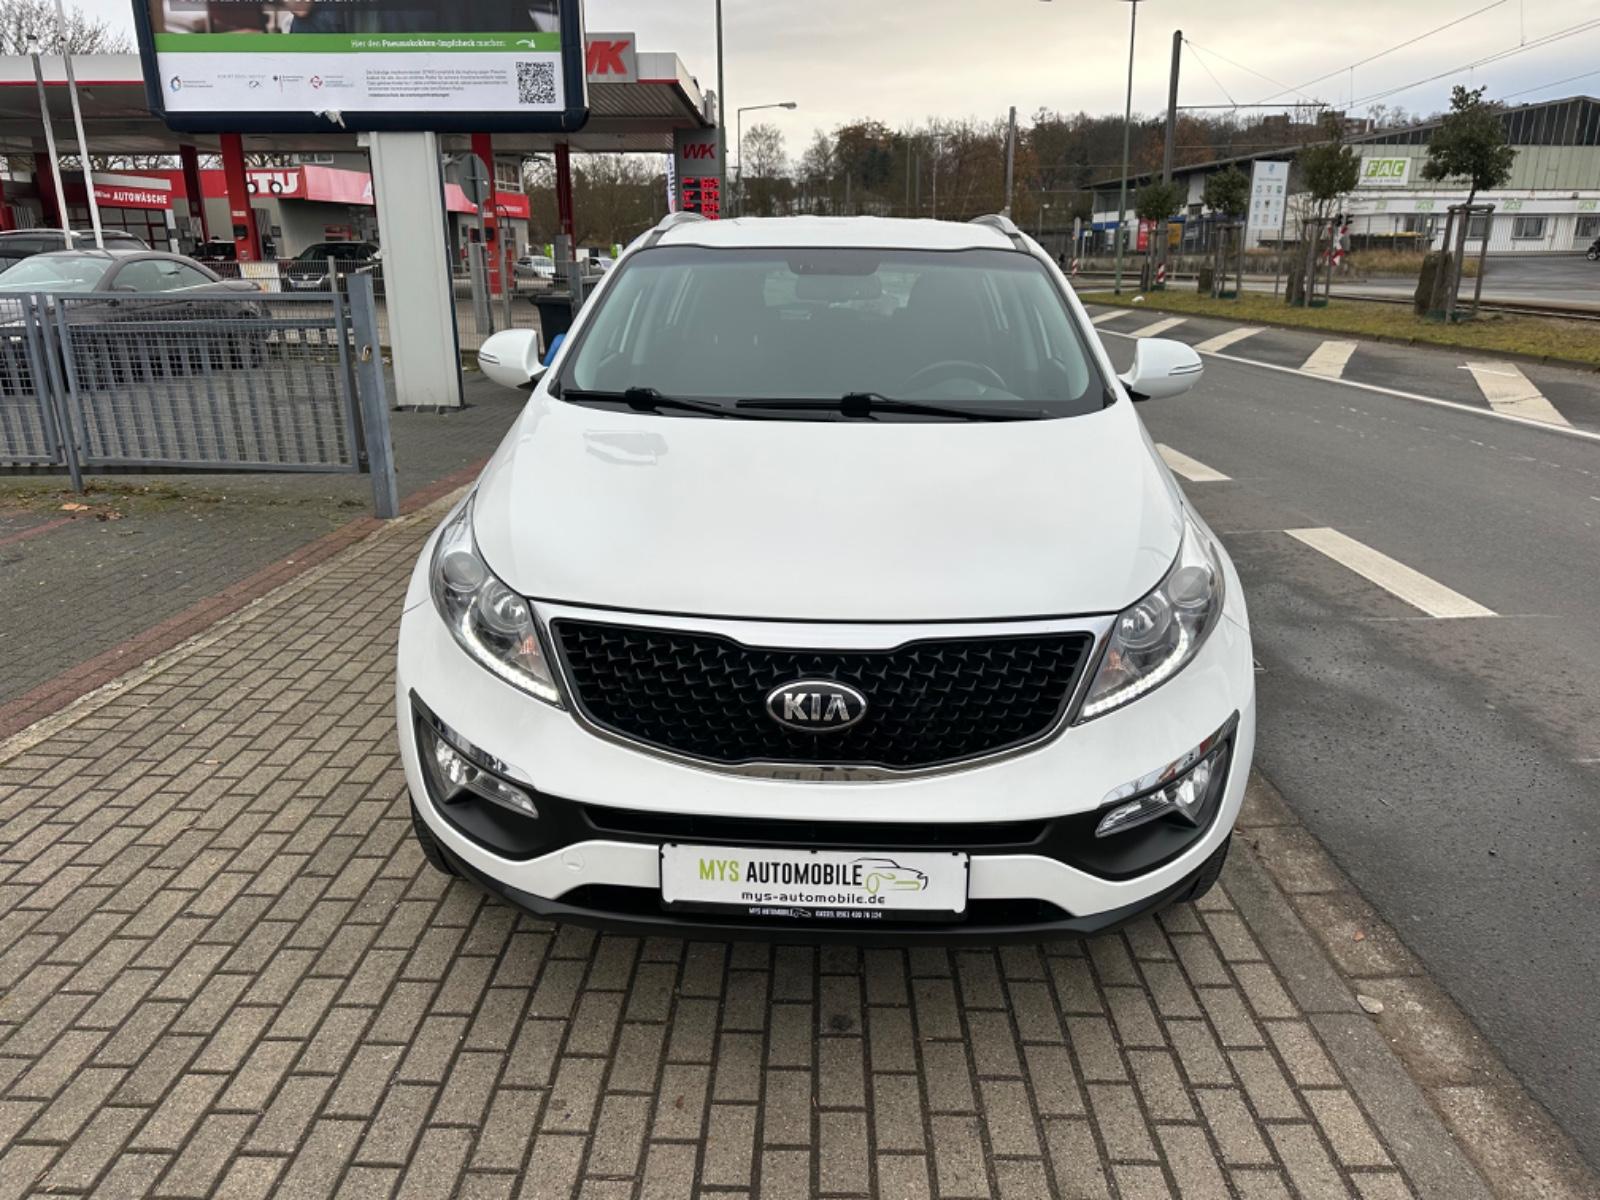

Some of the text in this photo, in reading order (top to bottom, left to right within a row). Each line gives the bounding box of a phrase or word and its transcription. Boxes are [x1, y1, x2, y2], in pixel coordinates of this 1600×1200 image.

[683, 143, 716, 160] WK
[1366, 160, 1406, 176] FAC
[112, 191, 168, 204] AUTOWÄSCHE
[783, 692, 850, 721] KIA
[699, 858, 863, 887] MYS AUTOMOBILE
[741, 891, 886, 905] mys-automobile.de
